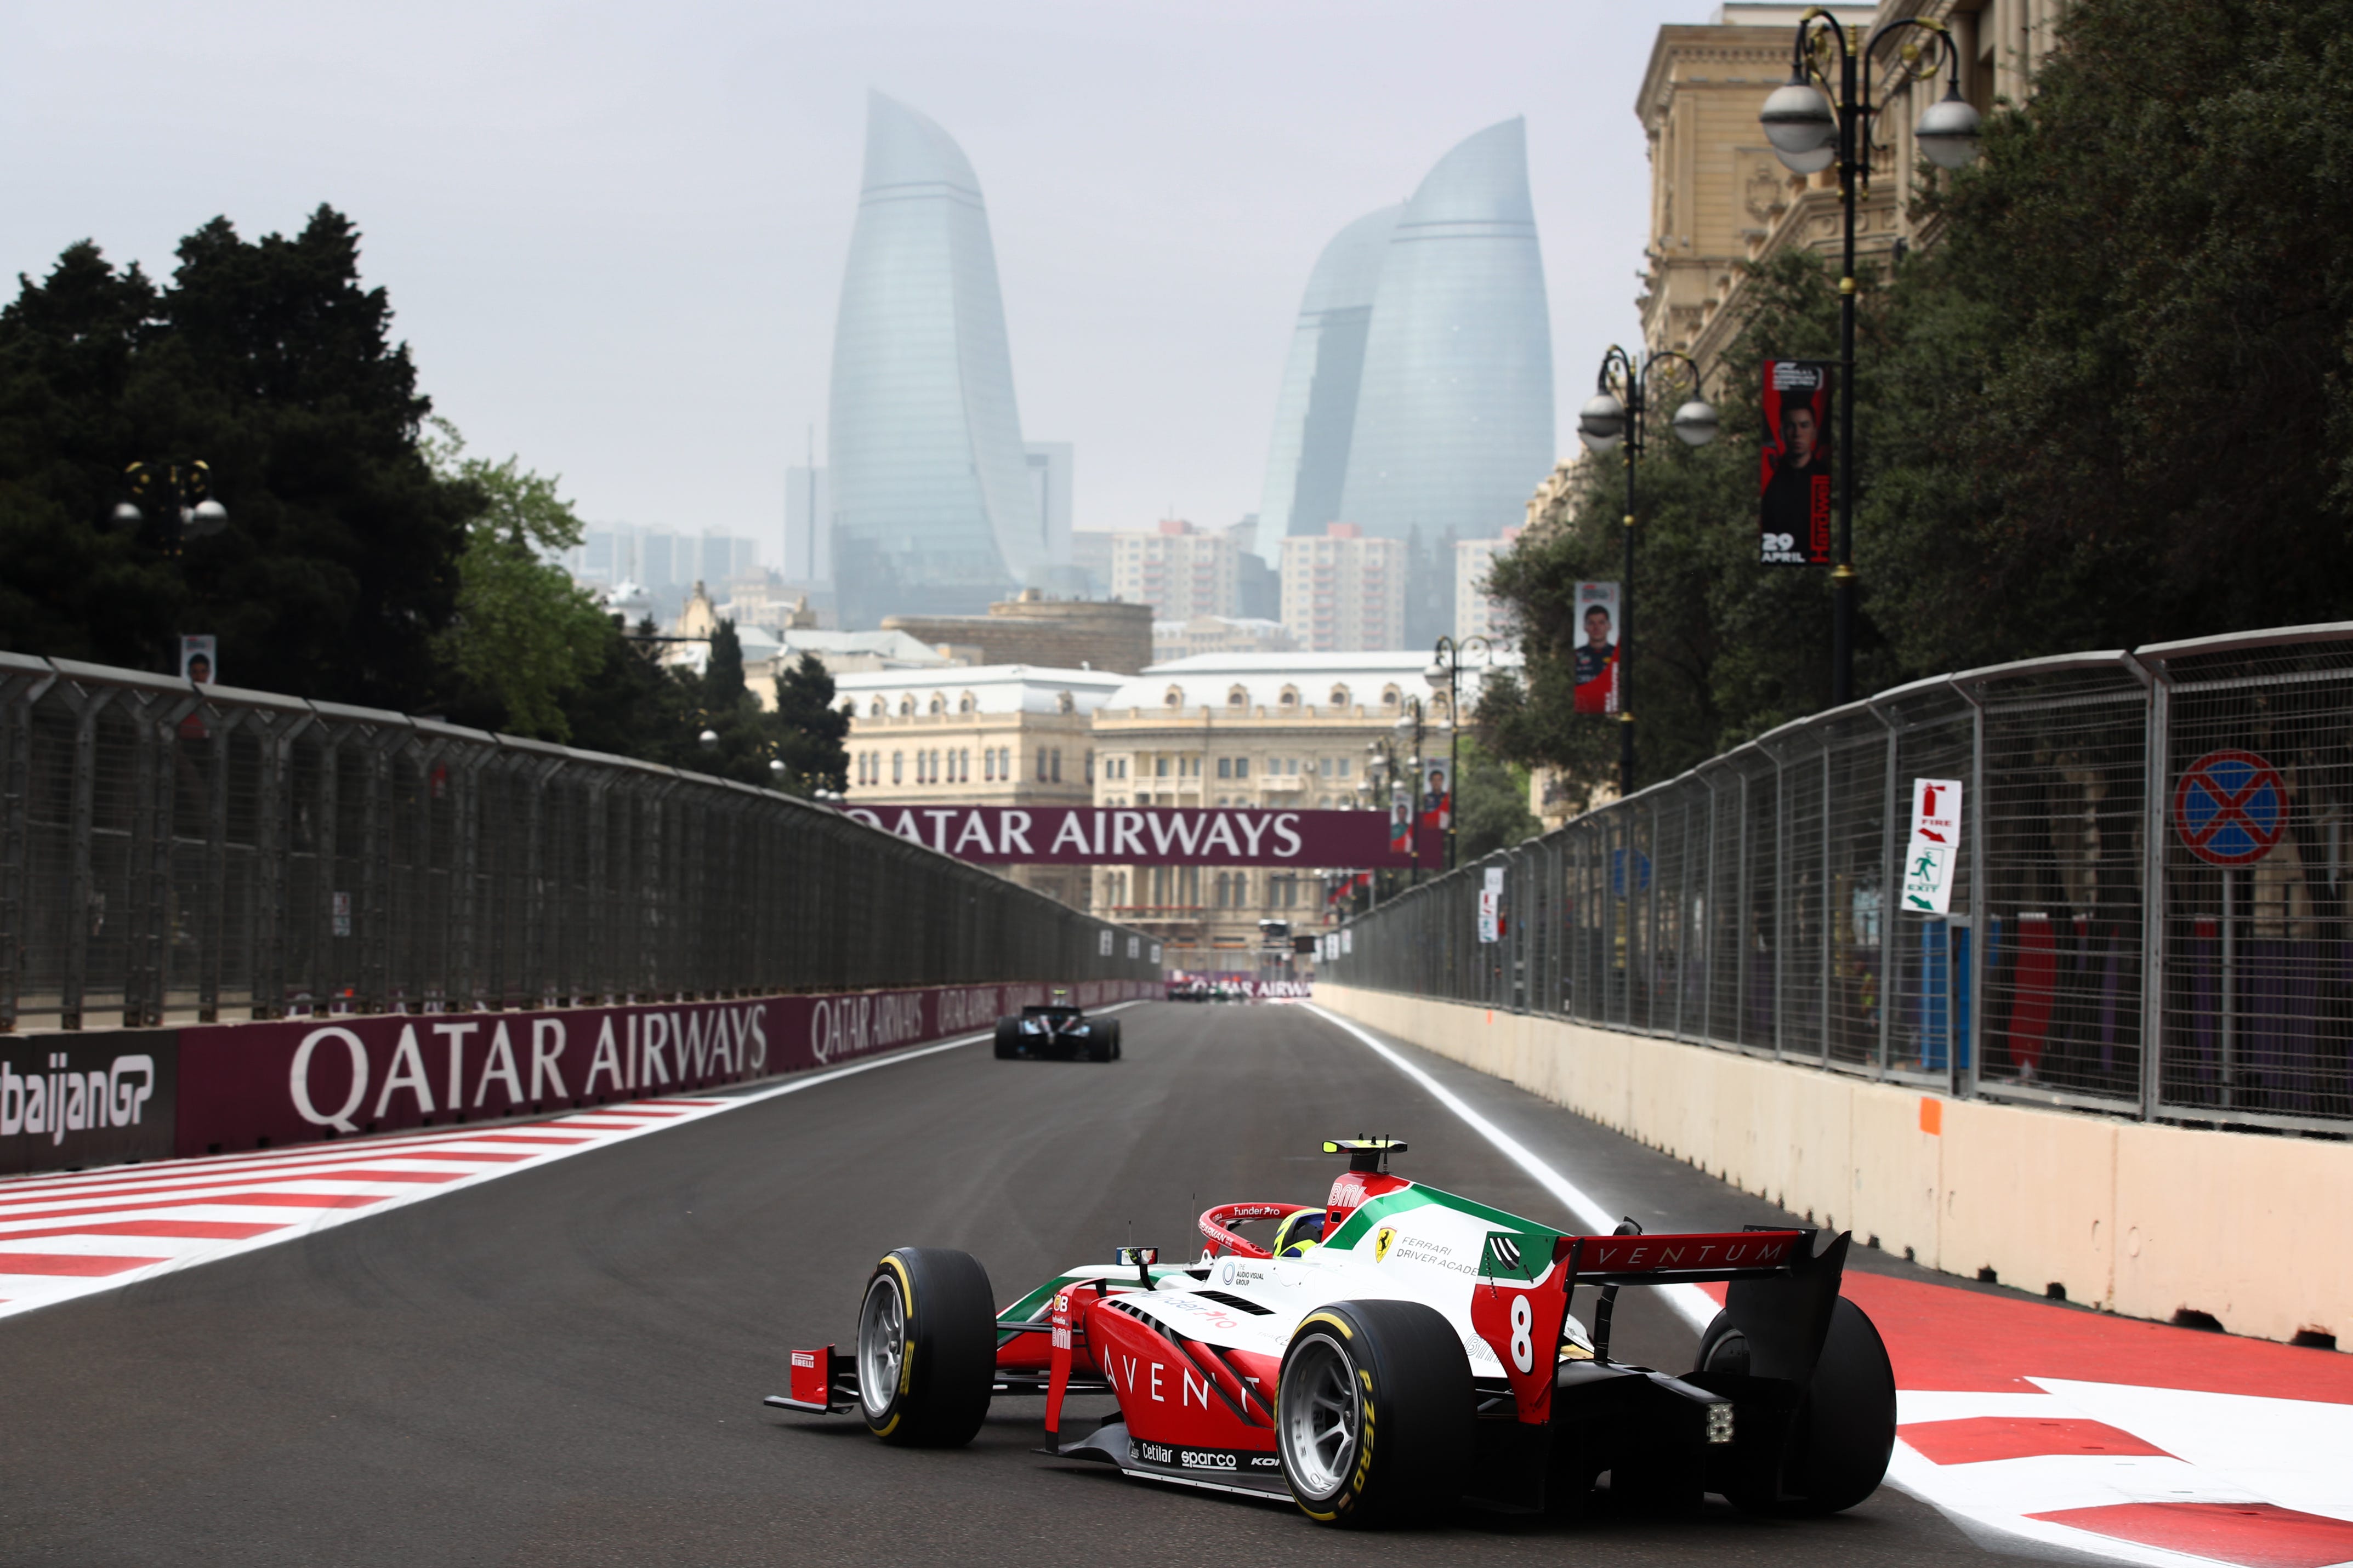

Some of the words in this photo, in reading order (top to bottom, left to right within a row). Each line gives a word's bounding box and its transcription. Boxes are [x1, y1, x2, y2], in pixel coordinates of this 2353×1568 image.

[1810, 475, 1830, 563] Hardwell
[1761, 532, 1794, 551] 29
[1761, 551, 1806, 563] APRIL
[1050, 811, 1302, 857] AIRWAYS
[1922, 819, 1952, 828] FIRE
[1907, 884, 1937, 893] EXIT
[811, 996, 871, 1064] QATAR
[872, 992, 923, 1046] AIRWAYS
[290, 1018, 569, 1133] QATAR
[584, 1004, 767, 1096] AIRWAYS
[0, 1052, 154, 1146] baijanGP
[1327, 1182, 1367, 1208] BMI
[1397, 1248, 1437, 1264] DRIVER
[1402, 1236, 1452, 1256] FERRARI
[1599, 1244, 1783, 1264] VENTUM
[1510, 1295, 1533, 1373] 8
[792, 1353, 815, 1369] PIRELLI
[1358, 1369, 1373, 1393] P
[1143, 1442, 1173, 1463] Cetilar
[1354, 1398, 1376, 1494] ZERO
[1181, 1451, 1237, 1468] sparco
